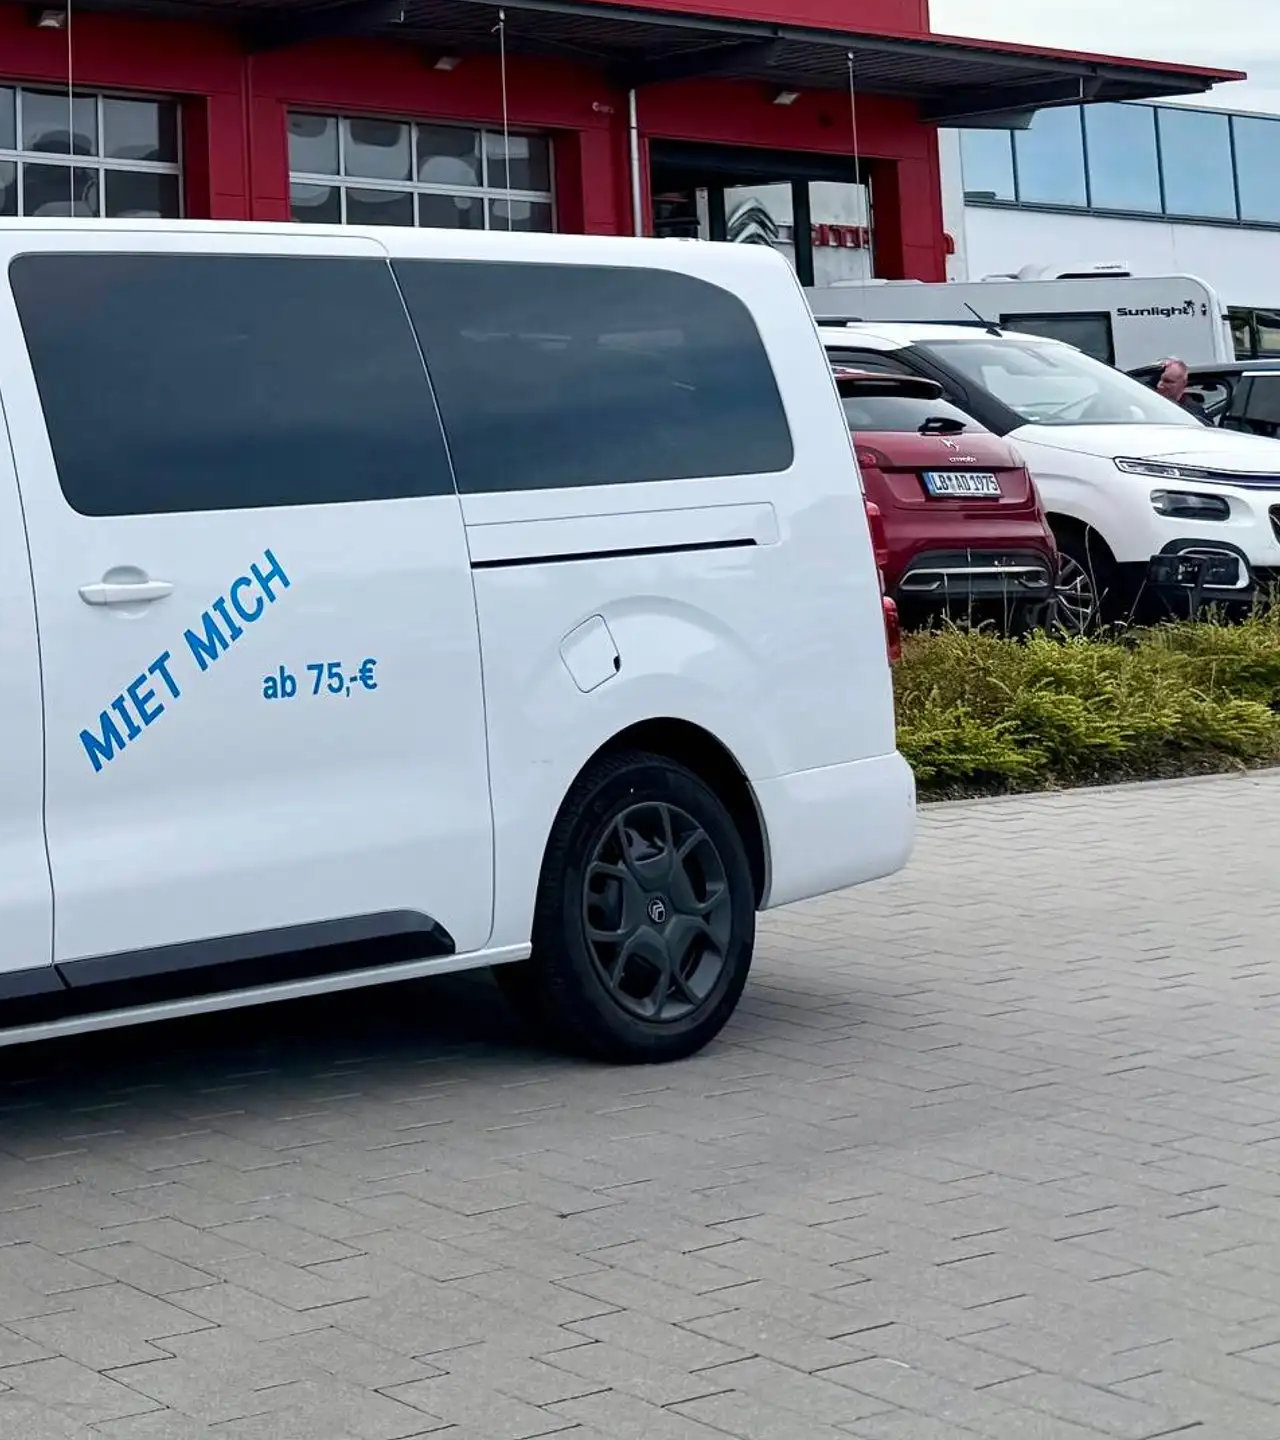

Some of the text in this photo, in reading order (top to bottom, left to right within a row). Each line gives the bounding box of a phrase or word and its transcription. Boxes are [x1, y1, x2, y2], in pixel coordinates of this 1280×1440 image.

[1116, 306, 1190, 318] Sunlight
[79, 548, 291, 773] MIET MICH
[263, 658, 378, 700] ab 75,-€
